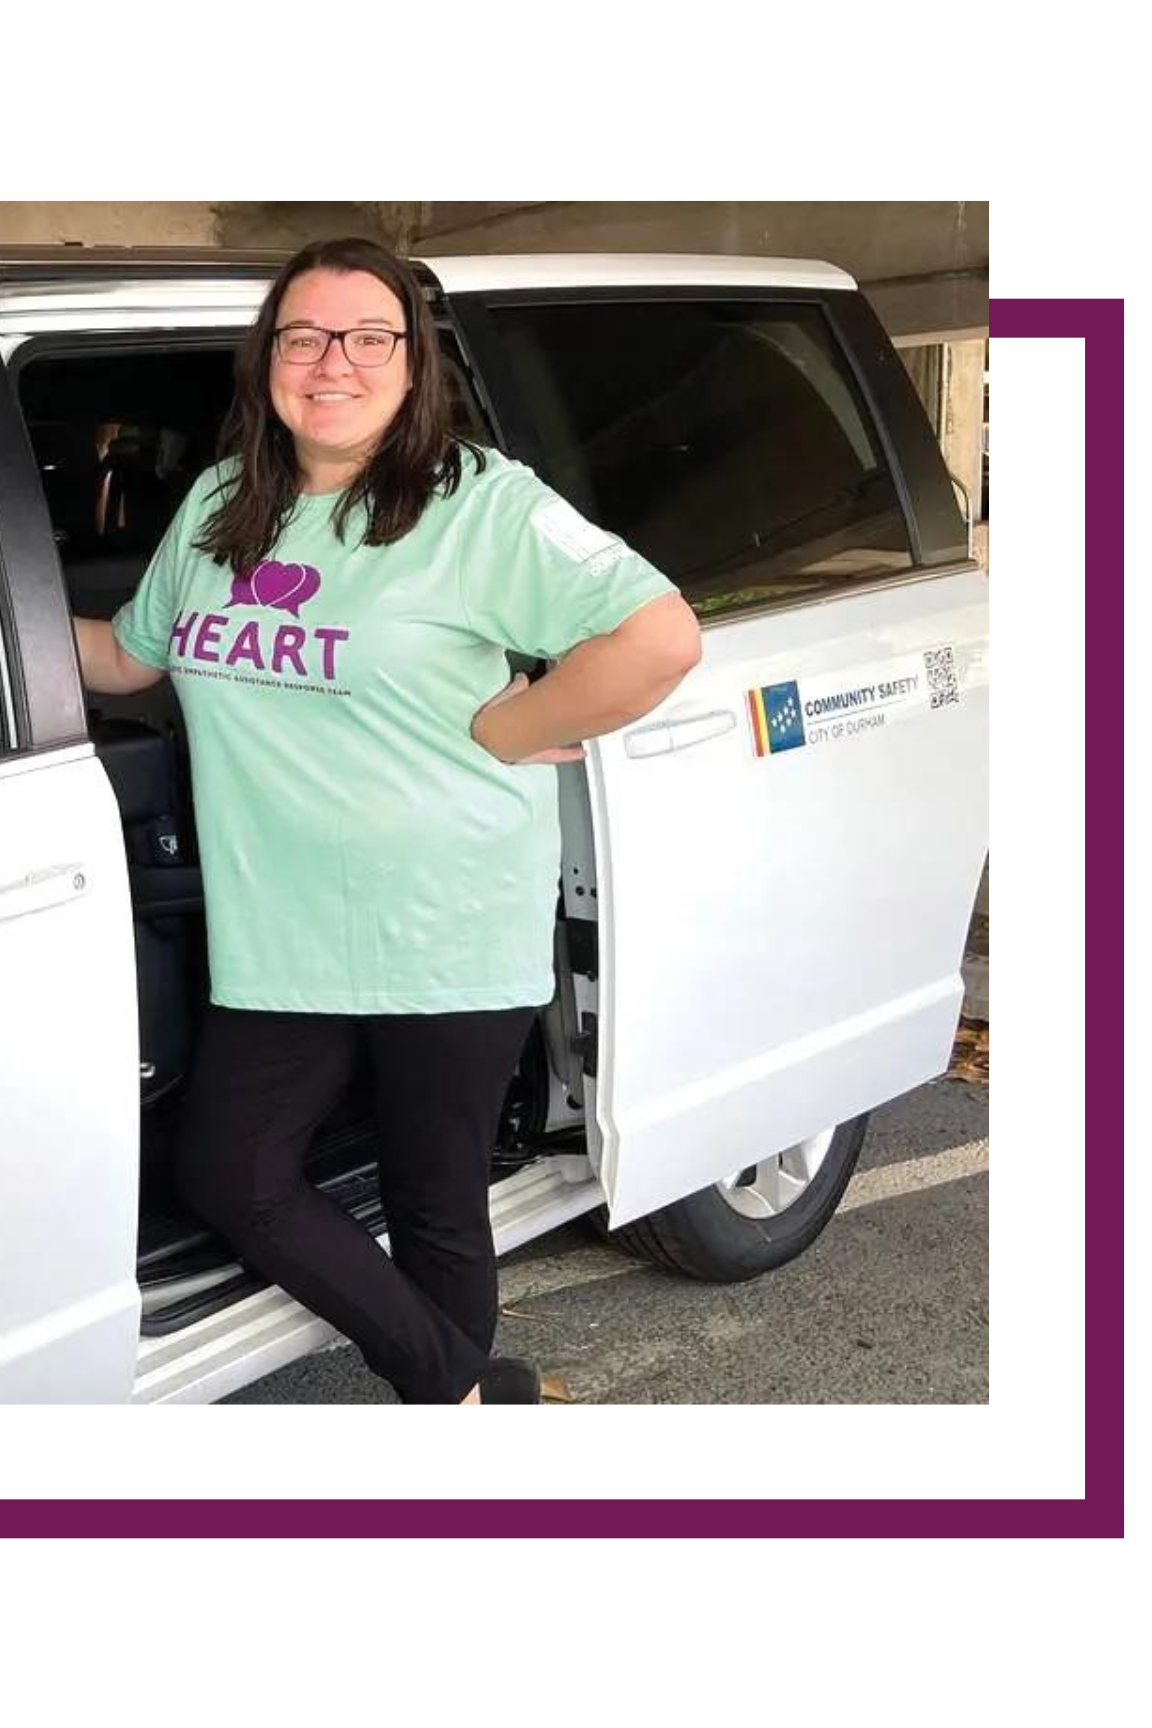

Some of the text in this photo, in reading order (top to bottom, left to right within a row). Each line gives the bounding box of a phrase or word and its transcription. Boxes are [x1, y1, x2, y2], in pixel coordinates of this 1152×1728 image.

[168, 610, 350, 681] HEART
[328, 687, 351, 697] TEAM
[805, 675, 919, 717] COMMUNITY SAFETY
[808, 713, 885, 744] CITY OF DURHAM
